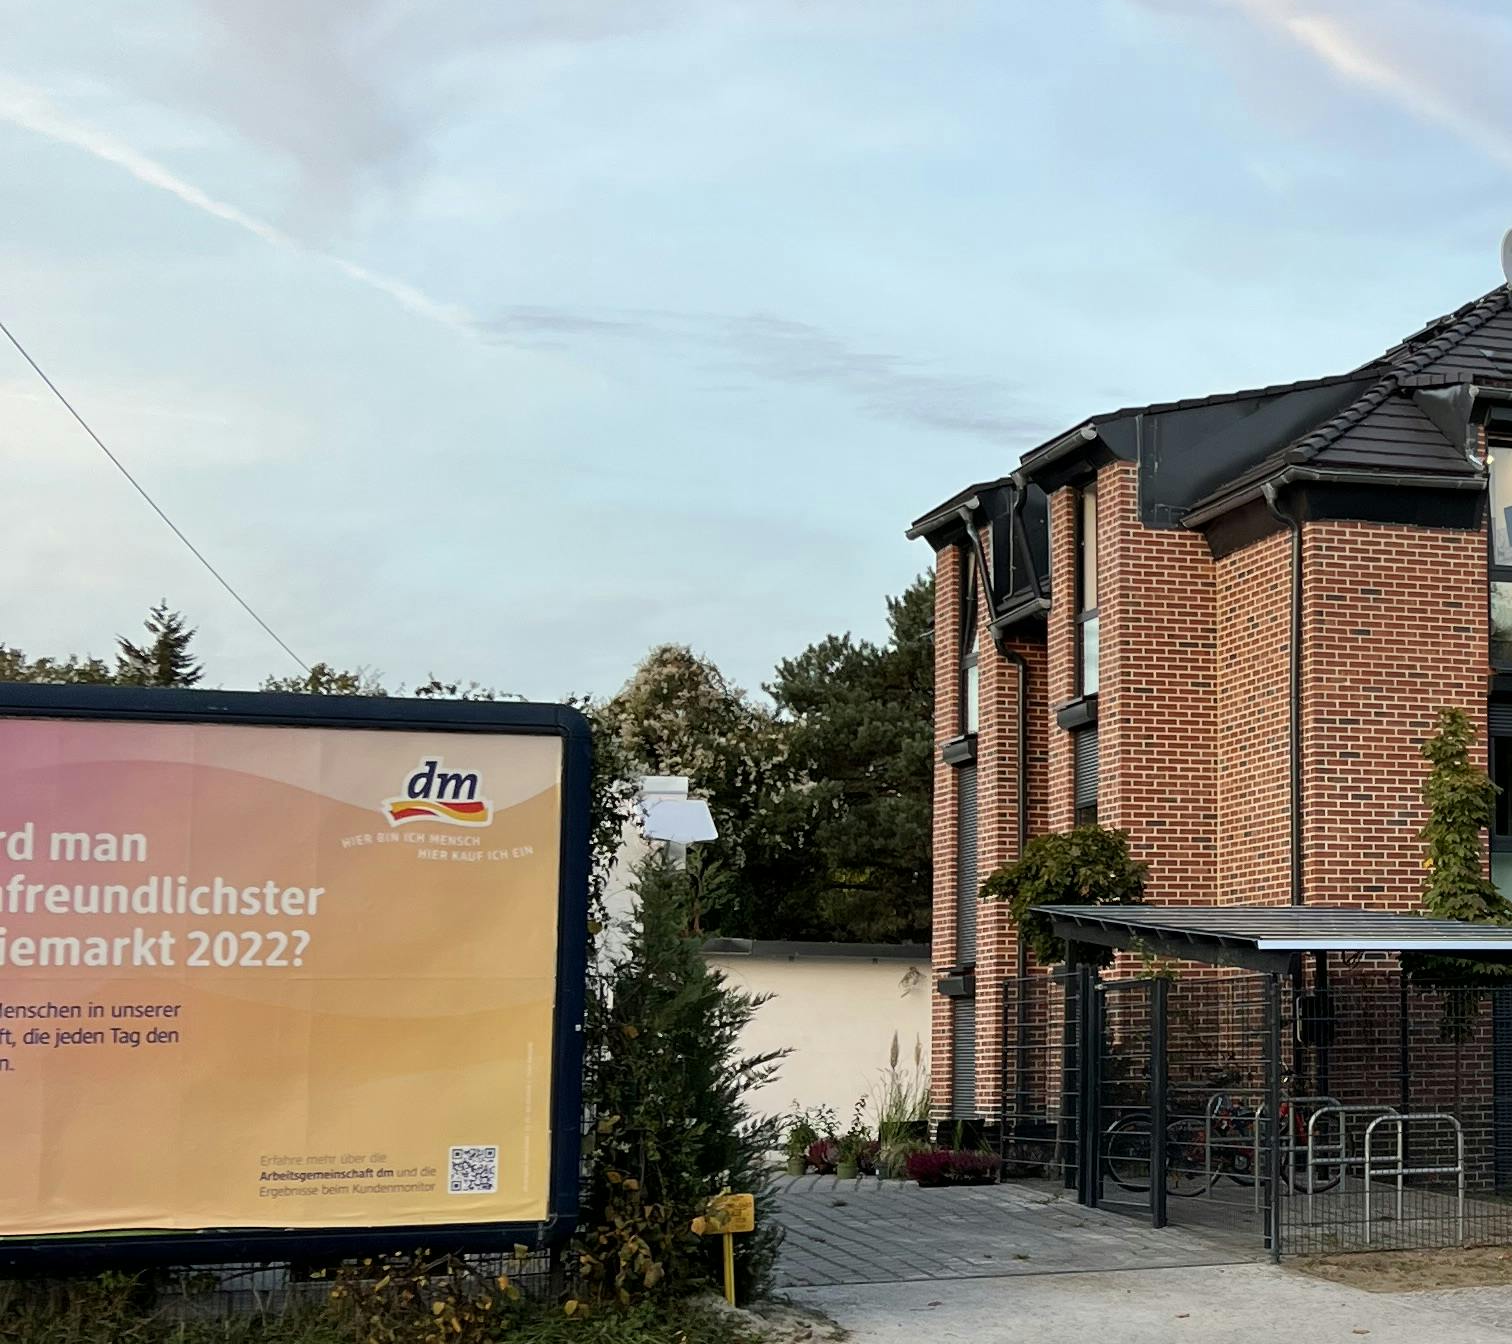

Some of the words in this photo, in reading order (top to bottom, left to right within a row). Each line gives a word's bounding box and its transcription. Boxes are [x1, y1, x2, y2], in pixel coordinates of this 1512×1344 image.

[407, 761, 478, 799] dm
[50, 832, 147, 862] man
[341, 833, 373, 848] HIER
[376, 832, 399, 844] BIN
[404, 832, 425, 844] ICH
[430, 833, 481, 846] MENSCH
[417, 849, 449, 861] HIER
[452, 849, 483, 862] KAUF
[488, 849, 508, 861] ICH
[512, 845, 534, 857] EIN
[186, 929, 311, 968] 2022?
[88, 1002, 104, 1019] in
[111, 1003, 181, 1019] unserer
[23, 1028, 50, 1045] die
[54, 1028, 104, 1048] jeden
[110, 1028, 140, 1048] Tag
[146, 1027, 179, 1044] den
[259, 1154, 306, 1166] Erfahre
[306, 1155, 336, 1165] mehr
[340, 1152, 366, 1164] über
[369, 1152, 387, 1163] die
[260, 1168, 374, 1183] Arbeitsgemeinschaft
[376, 1167, 394, 1178] dm
[396, 1167, 418, 1178] und
[420, 1165, 437, 1177] die
[259, 1186, 318, 1200] Ergebnisse
[321, 1184, 350, 1196] beim
[352, 1181, 437, 1195] Kundenmonitor
